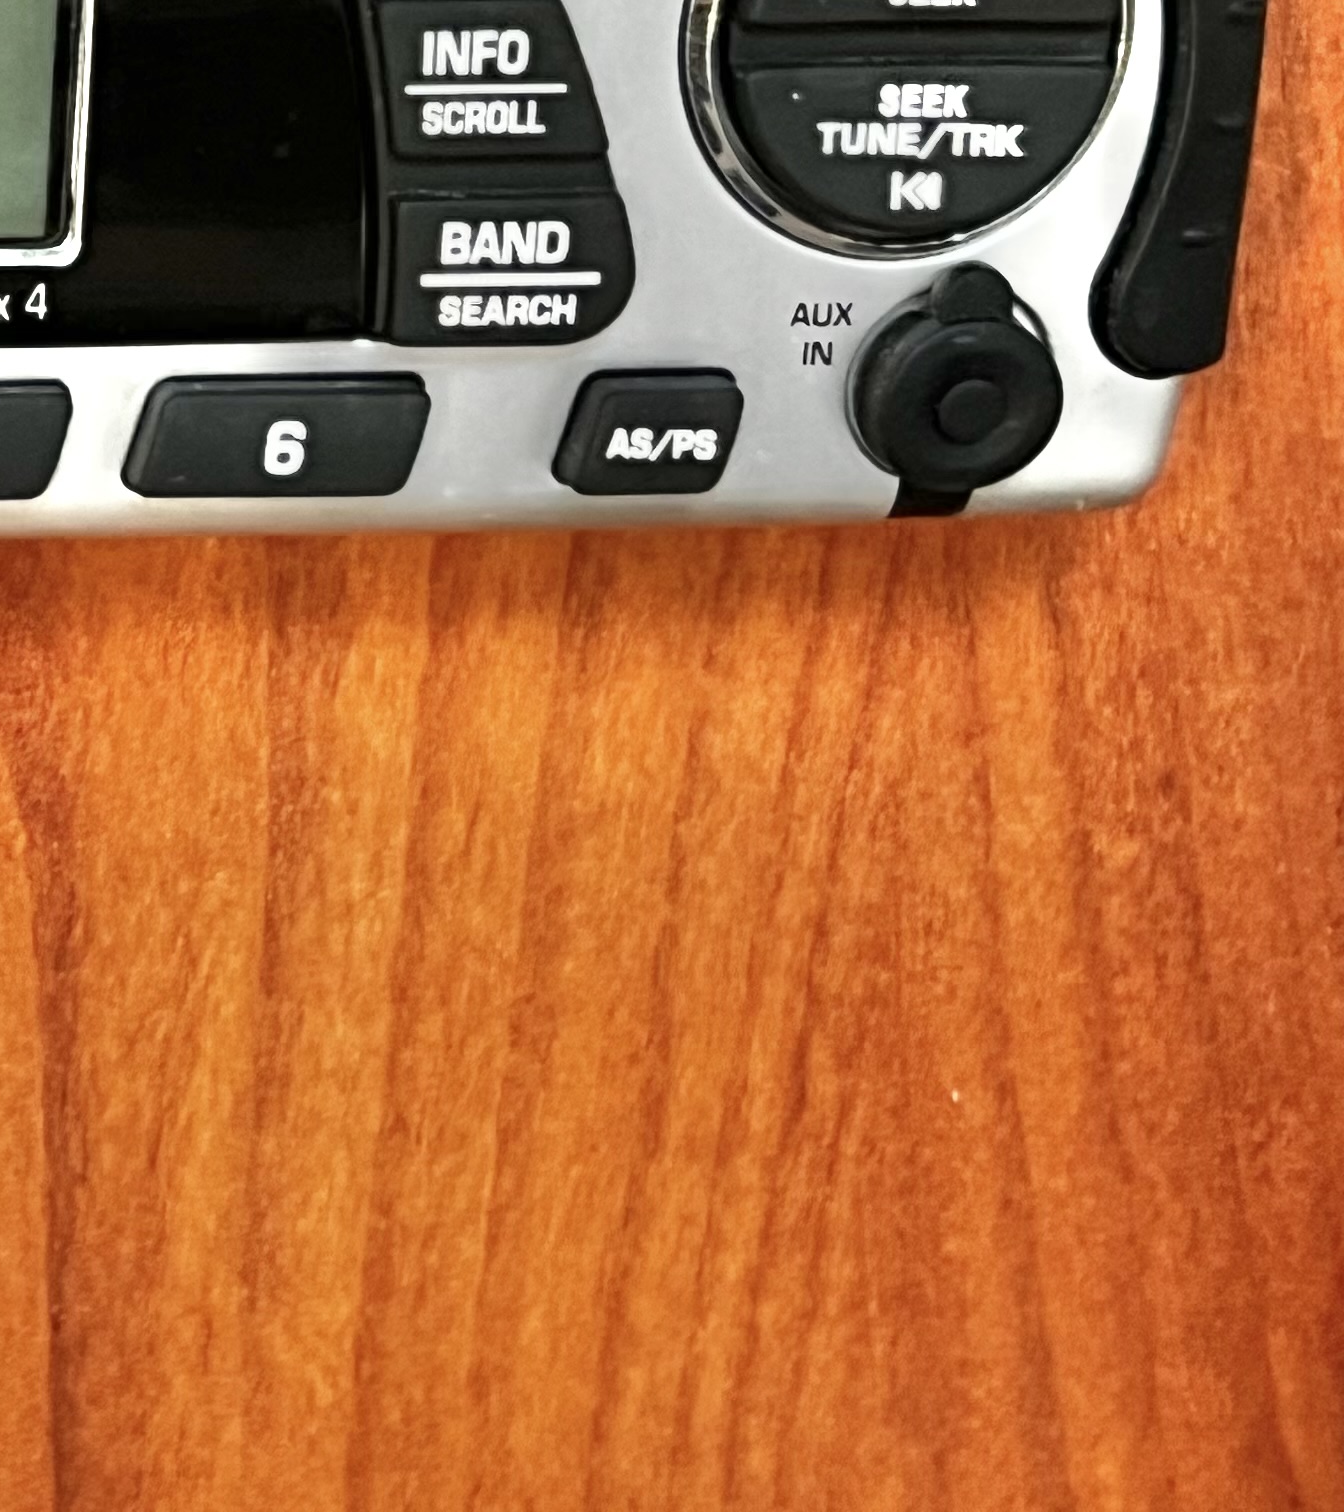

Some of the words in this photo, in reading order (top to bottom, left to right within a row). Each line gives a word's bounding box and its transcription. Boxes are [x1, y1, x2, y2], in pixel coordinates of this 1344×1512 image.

[422, 29, 530, 76] INFO
[421, 99, 547, 136] SCROLL
[877, 83, 970, 119] SEEK
[816, 121, 1025, 160] TUNE/TRK
[440, 220, 571, 266] BAND
[24, 282, 48, 320] 4
[437, 293, 578, 327] SEARCH
[790, 302, 853, 328] AUX
[802, 341, 833, 366] IN
[263, 420, 308, 476] 6
[605, 427, 718, 462] AS/PS
